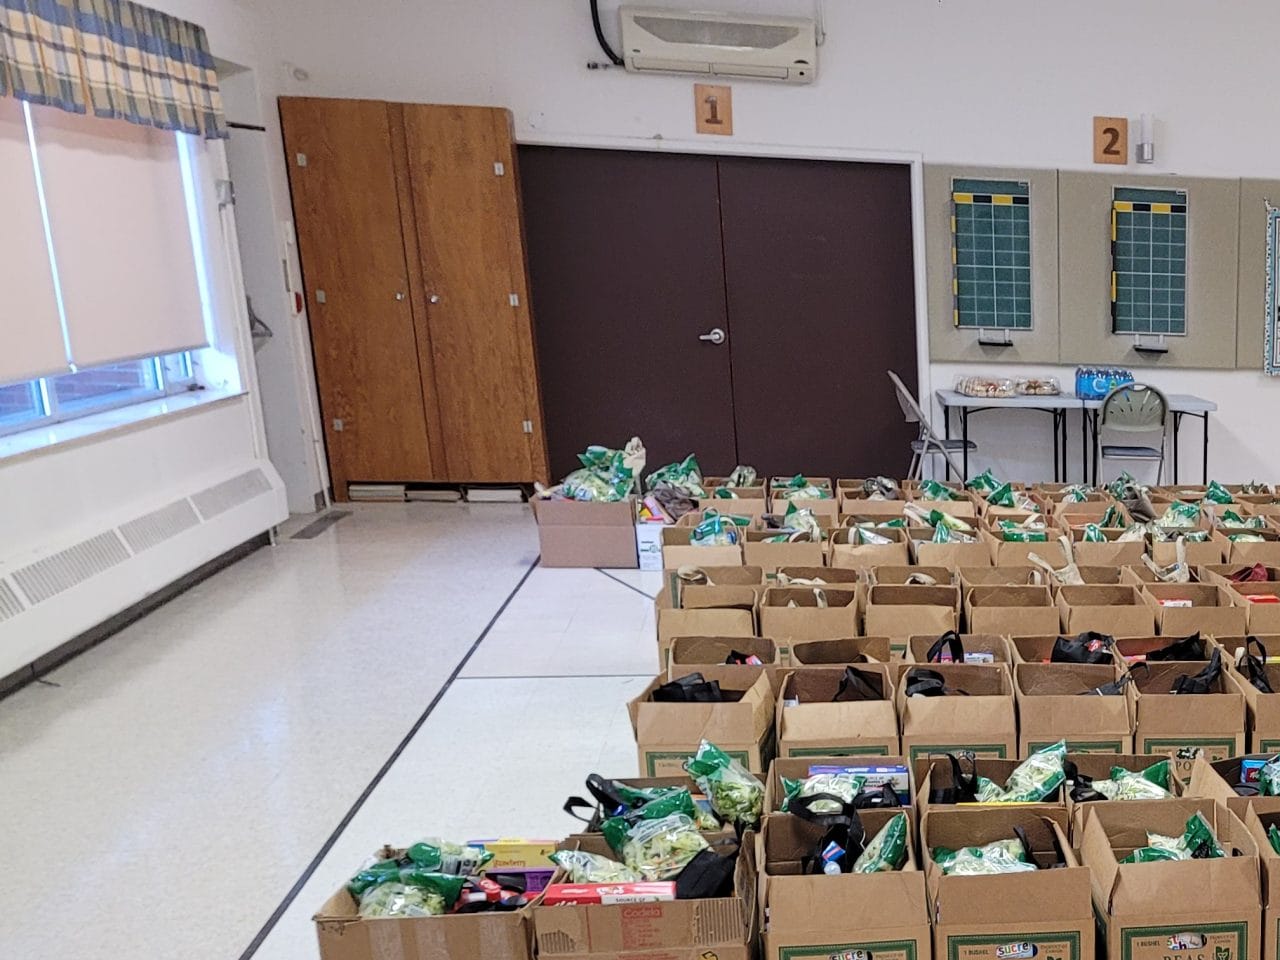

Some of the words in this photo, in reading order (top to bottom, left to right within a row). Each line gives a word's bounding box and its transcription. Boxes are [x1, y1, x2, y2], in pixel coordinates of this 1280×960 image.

[706, 95, 722, 125] 1
[1102, 127, 1120, 156] 2
[998, 942, 1029, 956] sucre
